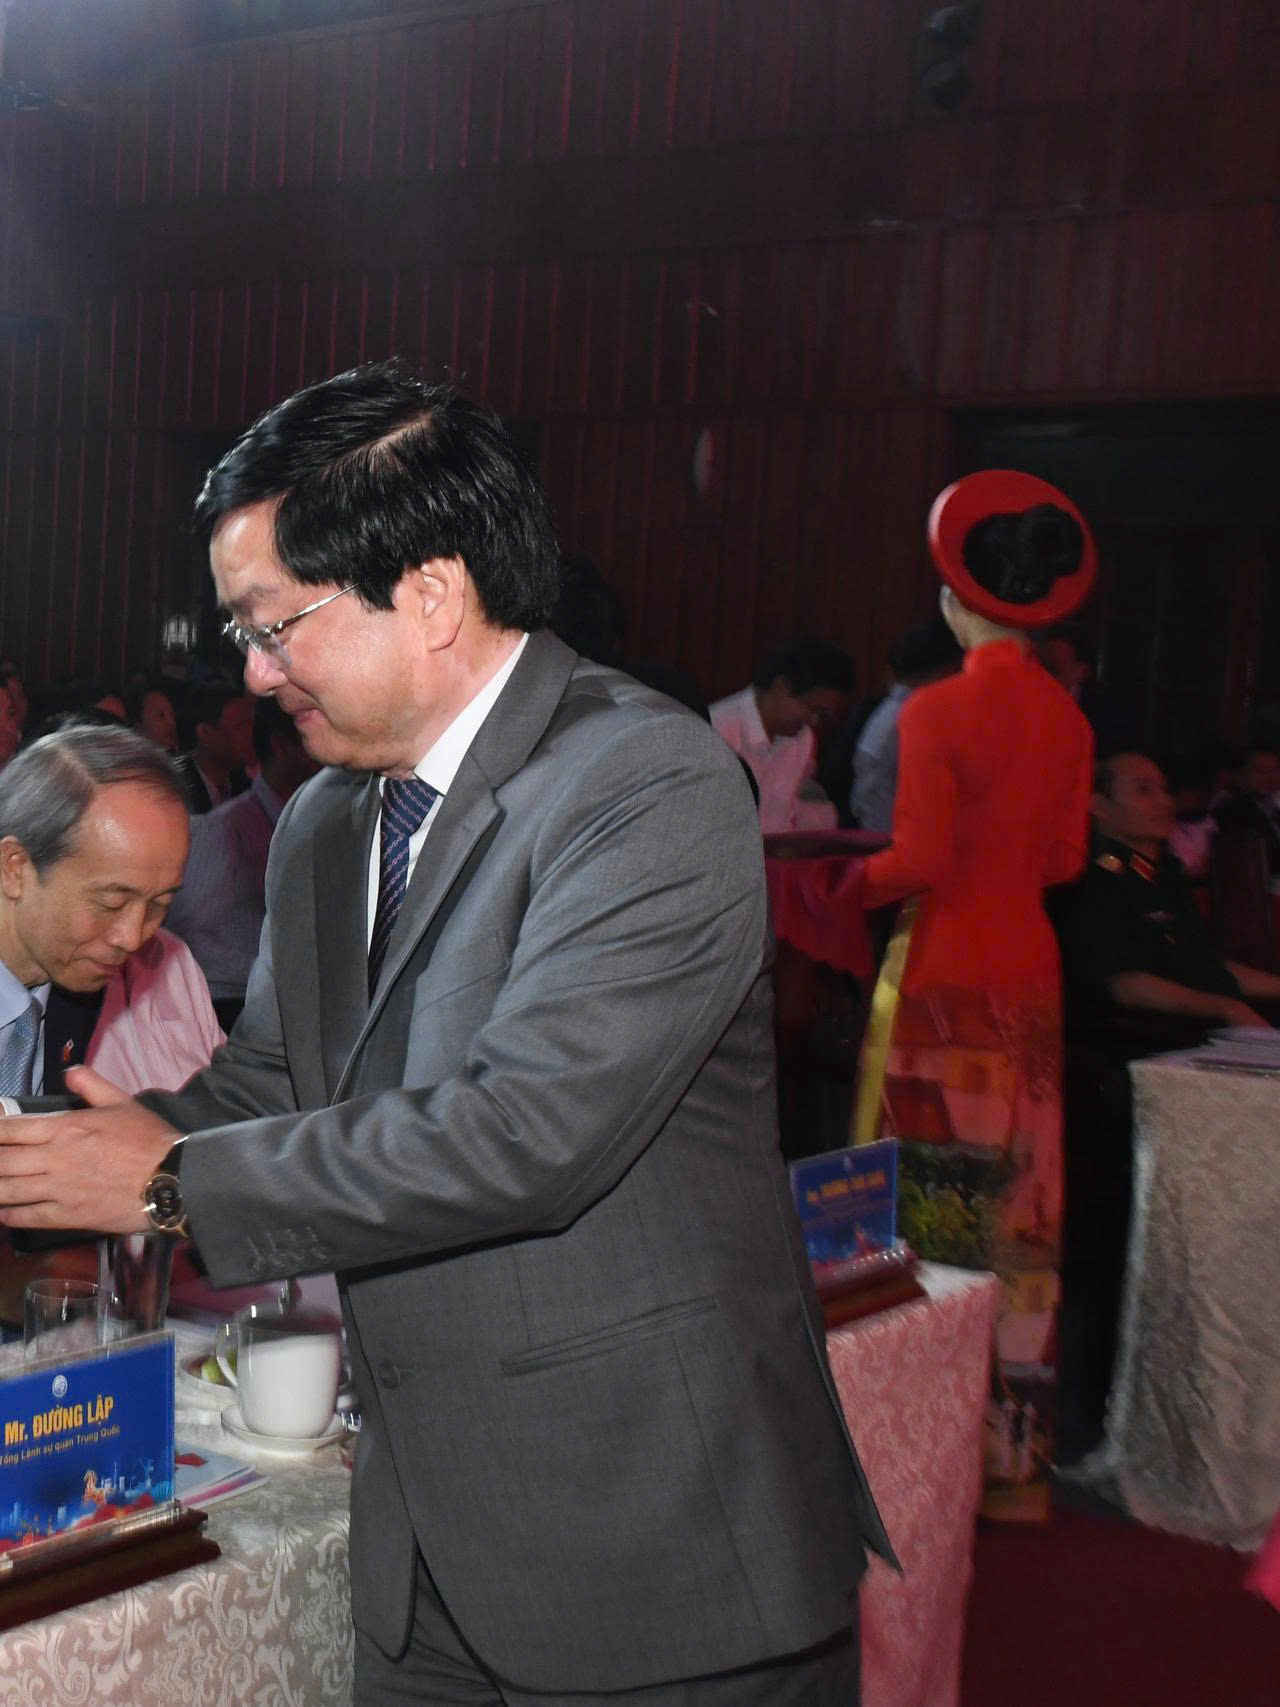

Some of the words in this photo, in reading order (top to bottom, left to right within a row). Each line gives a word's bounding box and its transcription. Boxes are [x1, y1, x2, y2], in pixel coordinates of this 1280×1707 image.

[4, 1420, 29, 1446] Mr.
[32, 1404, 83, 1438] ĐƯỜNG
[87, 1394, 114, 1425] LẬP
[76, 1431, 99, 1445] Trung
